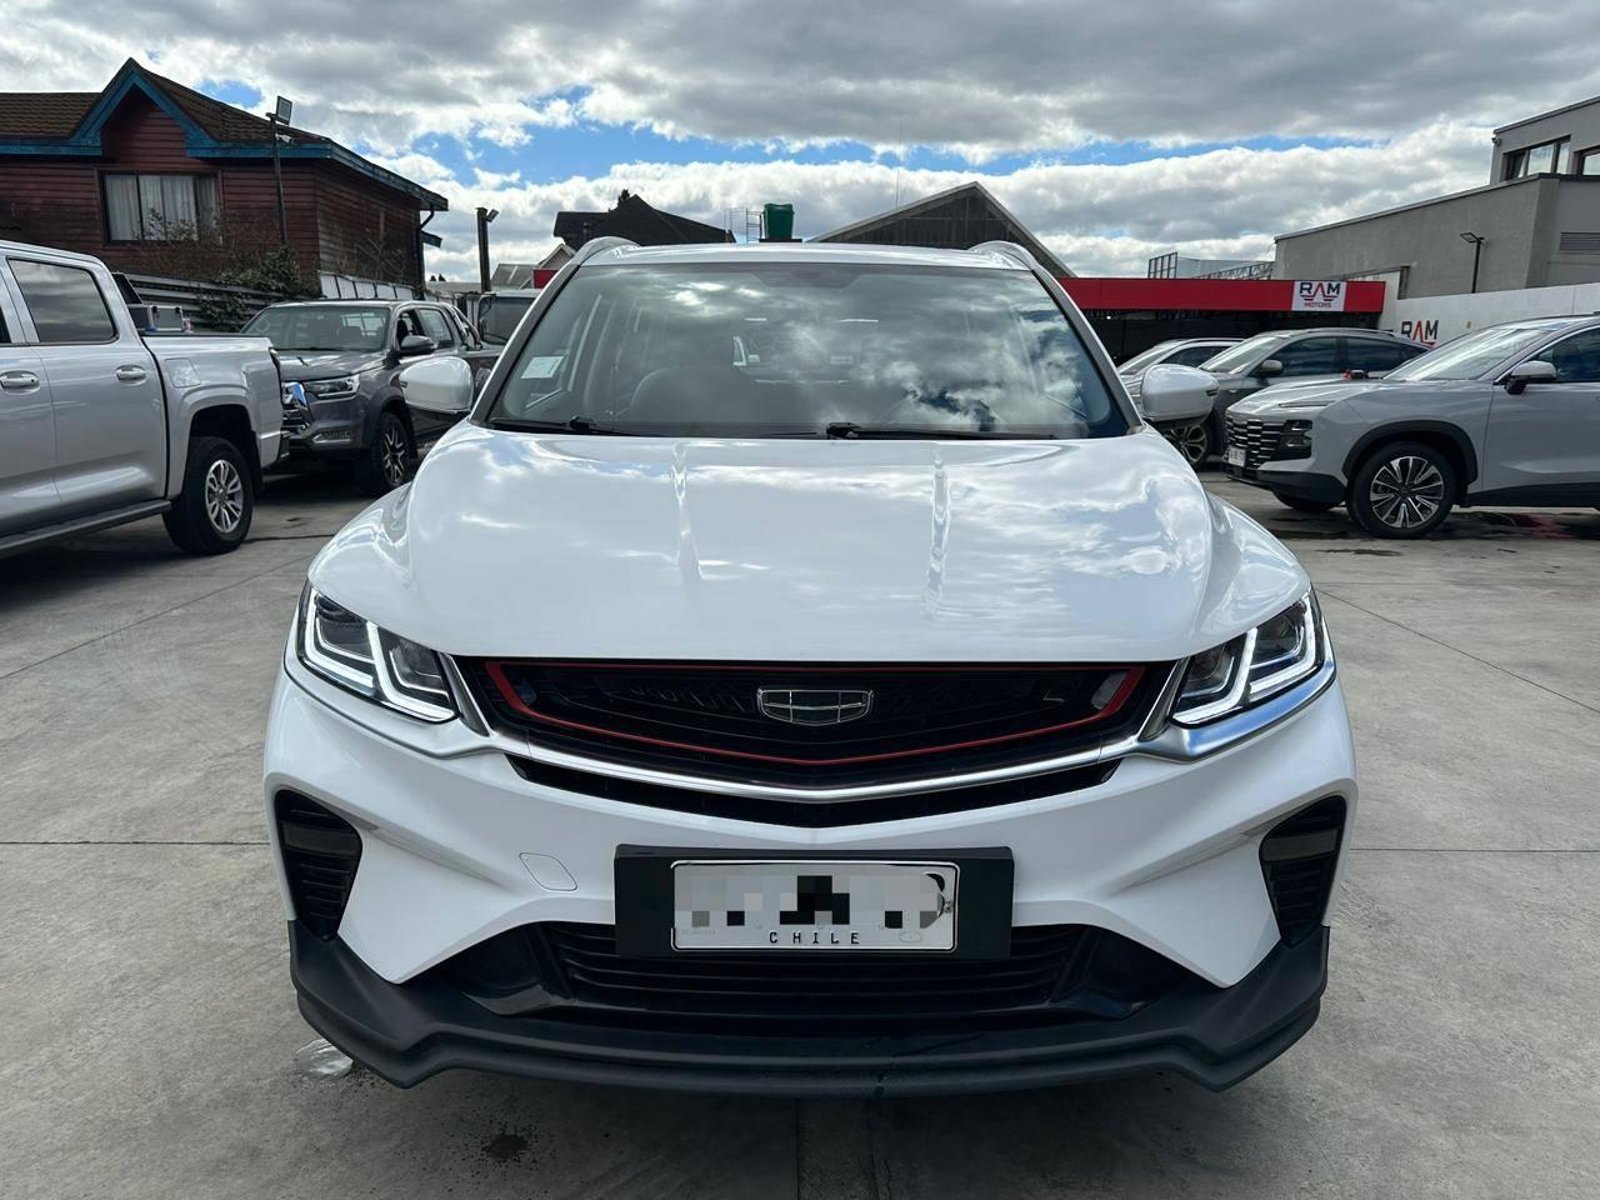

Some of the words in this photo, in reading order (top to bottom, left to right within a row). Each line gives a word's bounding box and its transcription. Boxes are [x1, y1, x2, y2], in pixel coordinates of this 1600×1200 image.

[1299, 281, 1341, 298] RAM
[1401, 319, 1439, 341] RAM
[769, 931, 860, 945] CHILE
